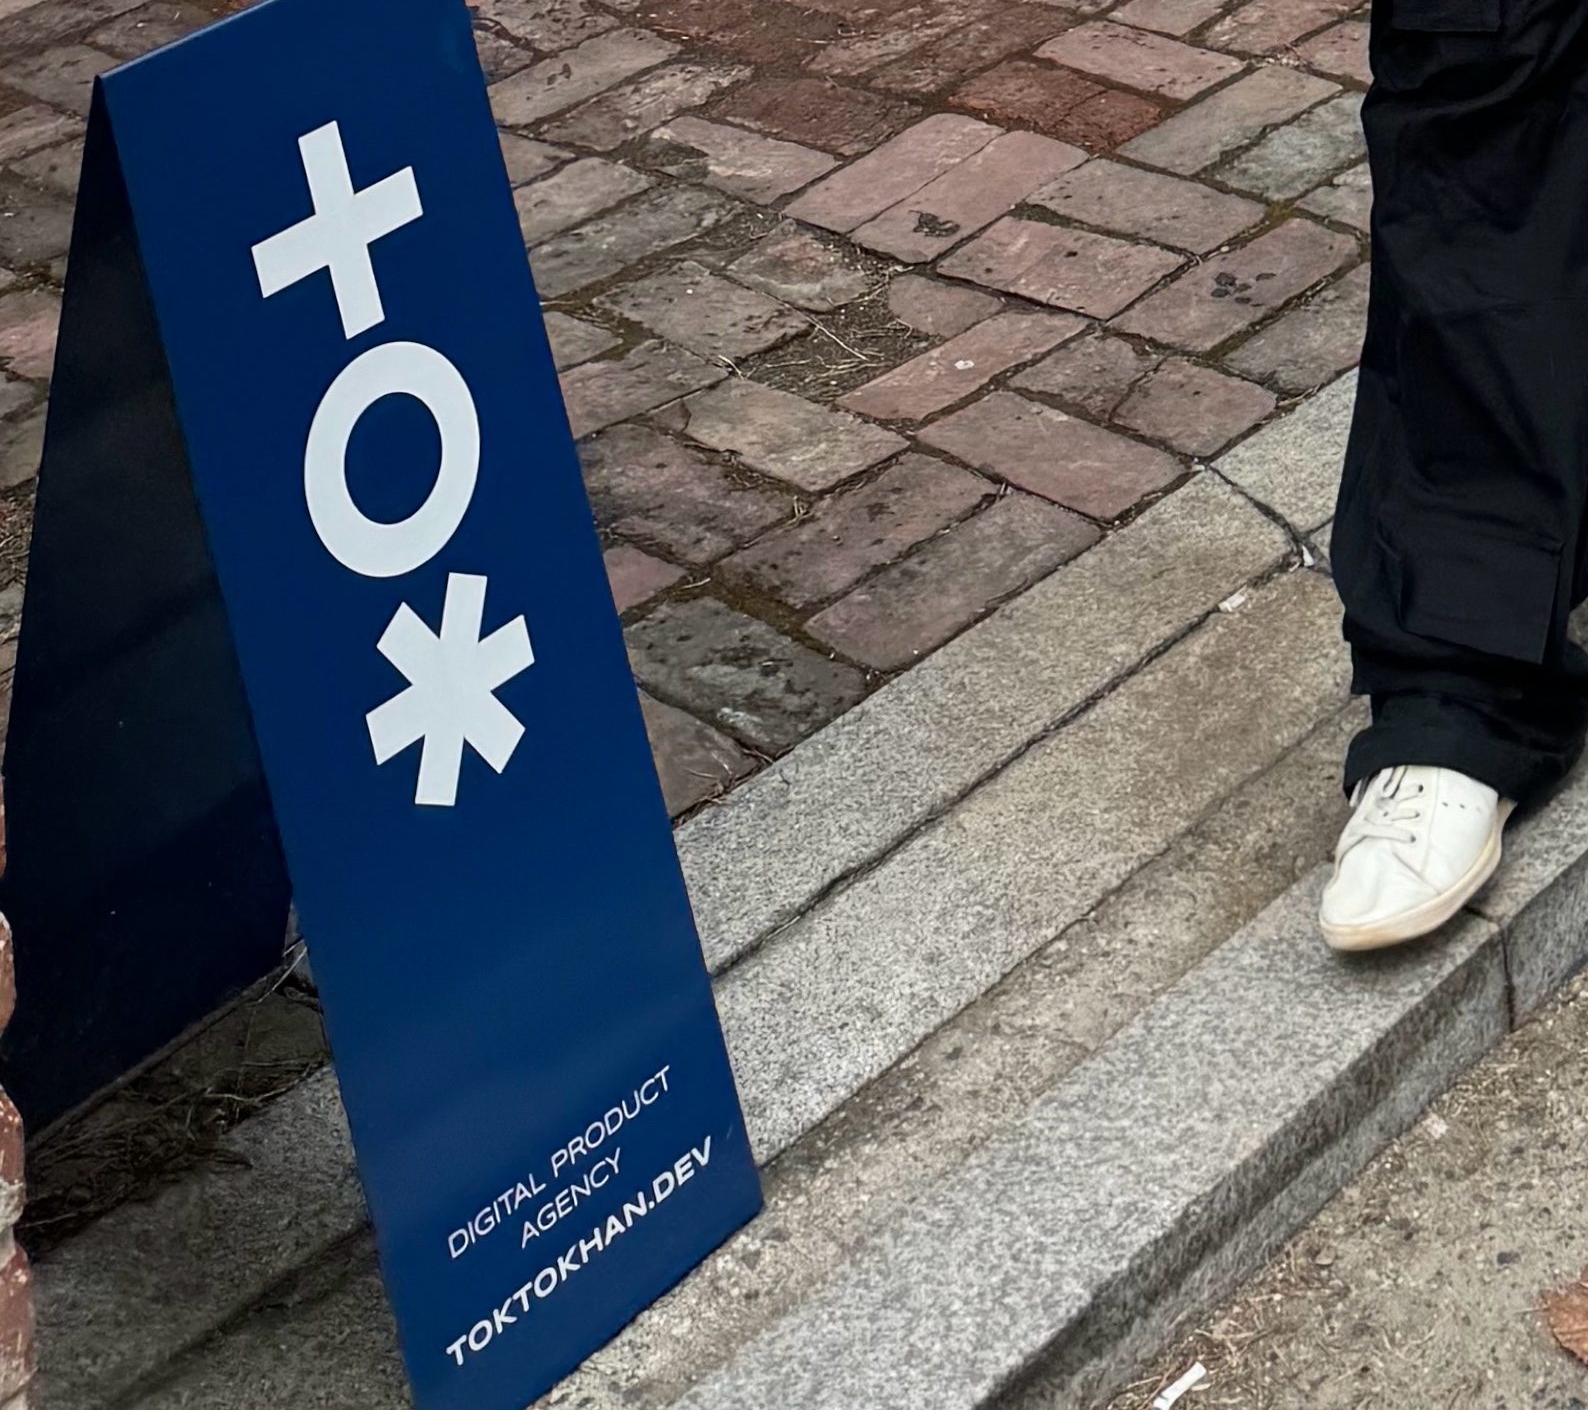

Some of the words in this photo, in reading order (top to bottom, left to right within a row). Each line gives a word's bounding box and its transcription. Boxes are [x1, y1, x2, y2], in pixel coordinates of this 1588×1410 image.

[445, 1134, 712, 1367] TOKTOKHAN.DEV
[447, 1172, 547, 1259] DIGITAL
[550, 1064, 671, 1179] PRODUCT
[521, 1146, 622, 1250] AGENCY
